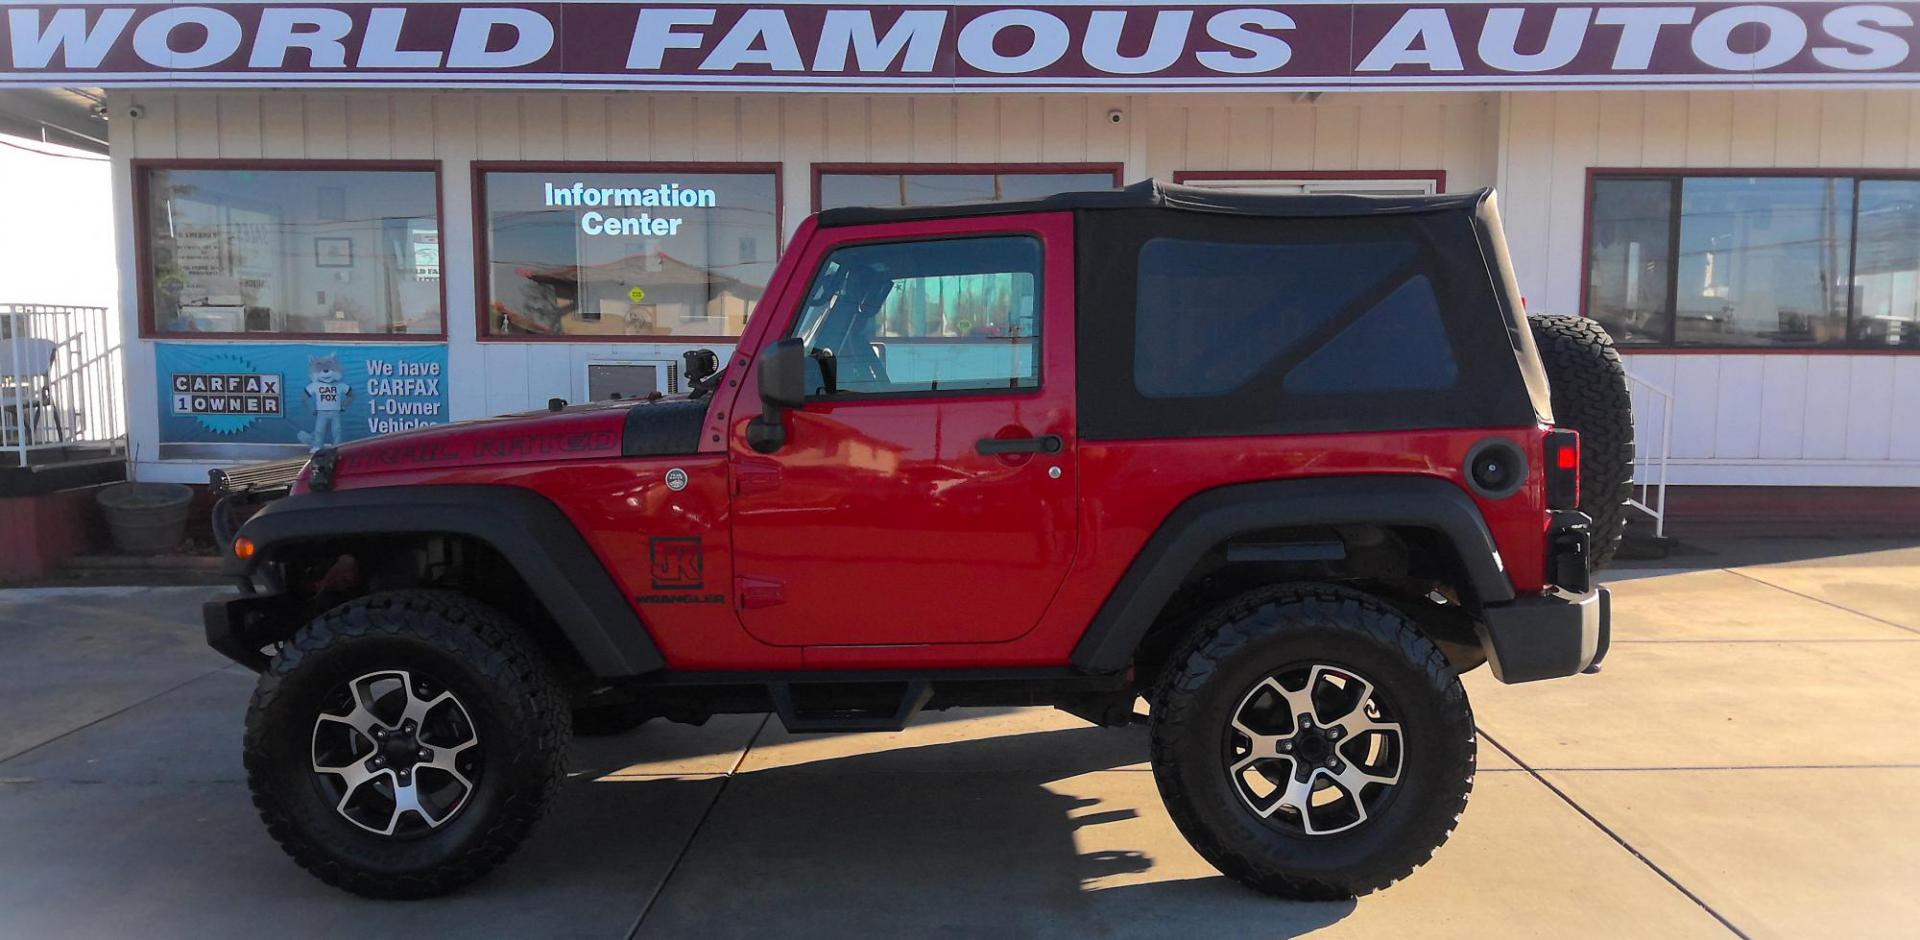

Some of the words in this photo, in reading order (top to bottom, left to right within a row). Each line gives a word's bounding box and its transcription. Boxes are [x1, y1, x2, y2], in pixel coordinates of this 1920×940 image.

[7, 6, 555, 69] WORLD
[625, 8, 1297, 74] FAMOUS
[1354, 5, 1914, 71] AUTOS
[544, 182, 716, 207] Information
[581, 212, 682, 235] Center
[366, 360, 393, 376] We
[399, 360, 440, 376] have
[174, 376, 279, 395] CARFAX
[318, 386, 337, 394] CAR
[366, 380, 440, 396] CARFAX
[177, 397, 189, 411] 1
[194, 398, 278, 413] OWNER
[320, 394, 337, 403] FOX
[368, 400, 441, 416] 1-Owner
